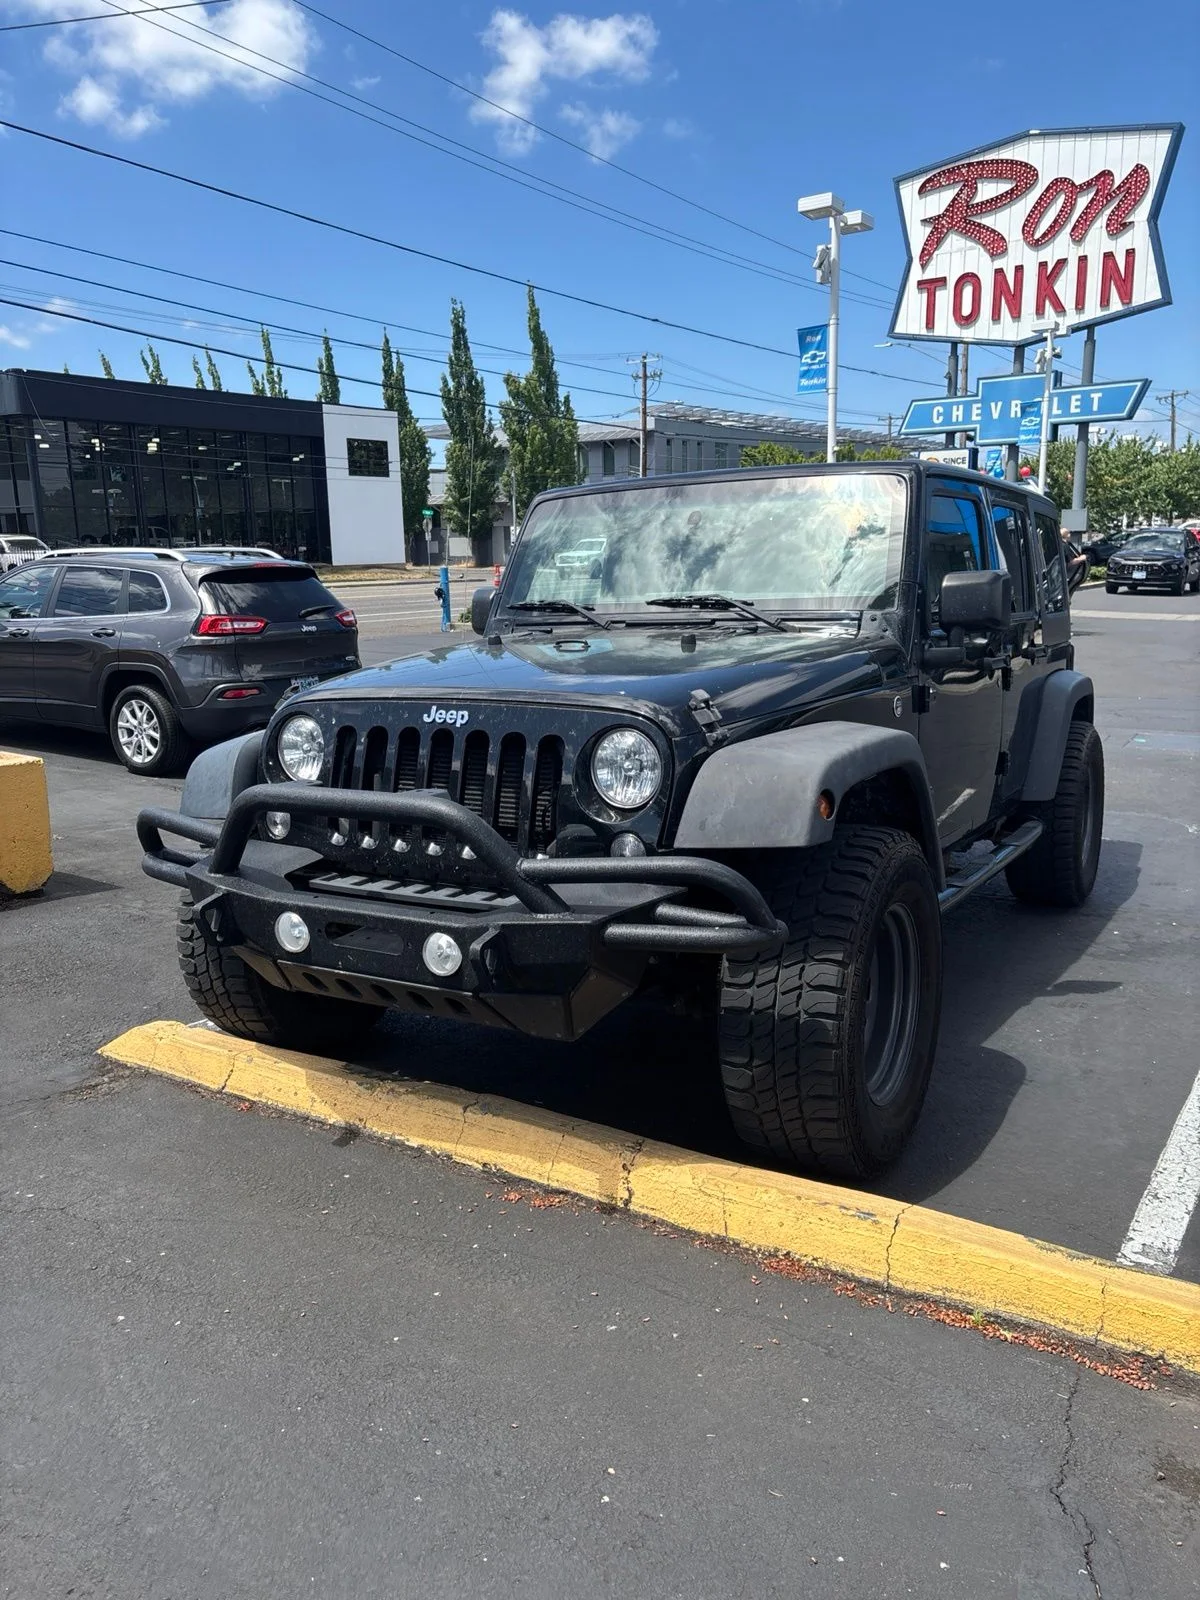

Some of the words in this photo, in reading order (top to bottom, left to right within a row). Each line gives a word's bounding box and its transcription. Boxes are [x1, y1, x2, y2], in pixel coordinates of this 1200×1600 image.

[918, 158, 1150, 272] Ron
[917, 248, 1136, 330] TONKIN
[943, 456, 967, 465] SINCE
[423, 705, 469, 728] Jeep
